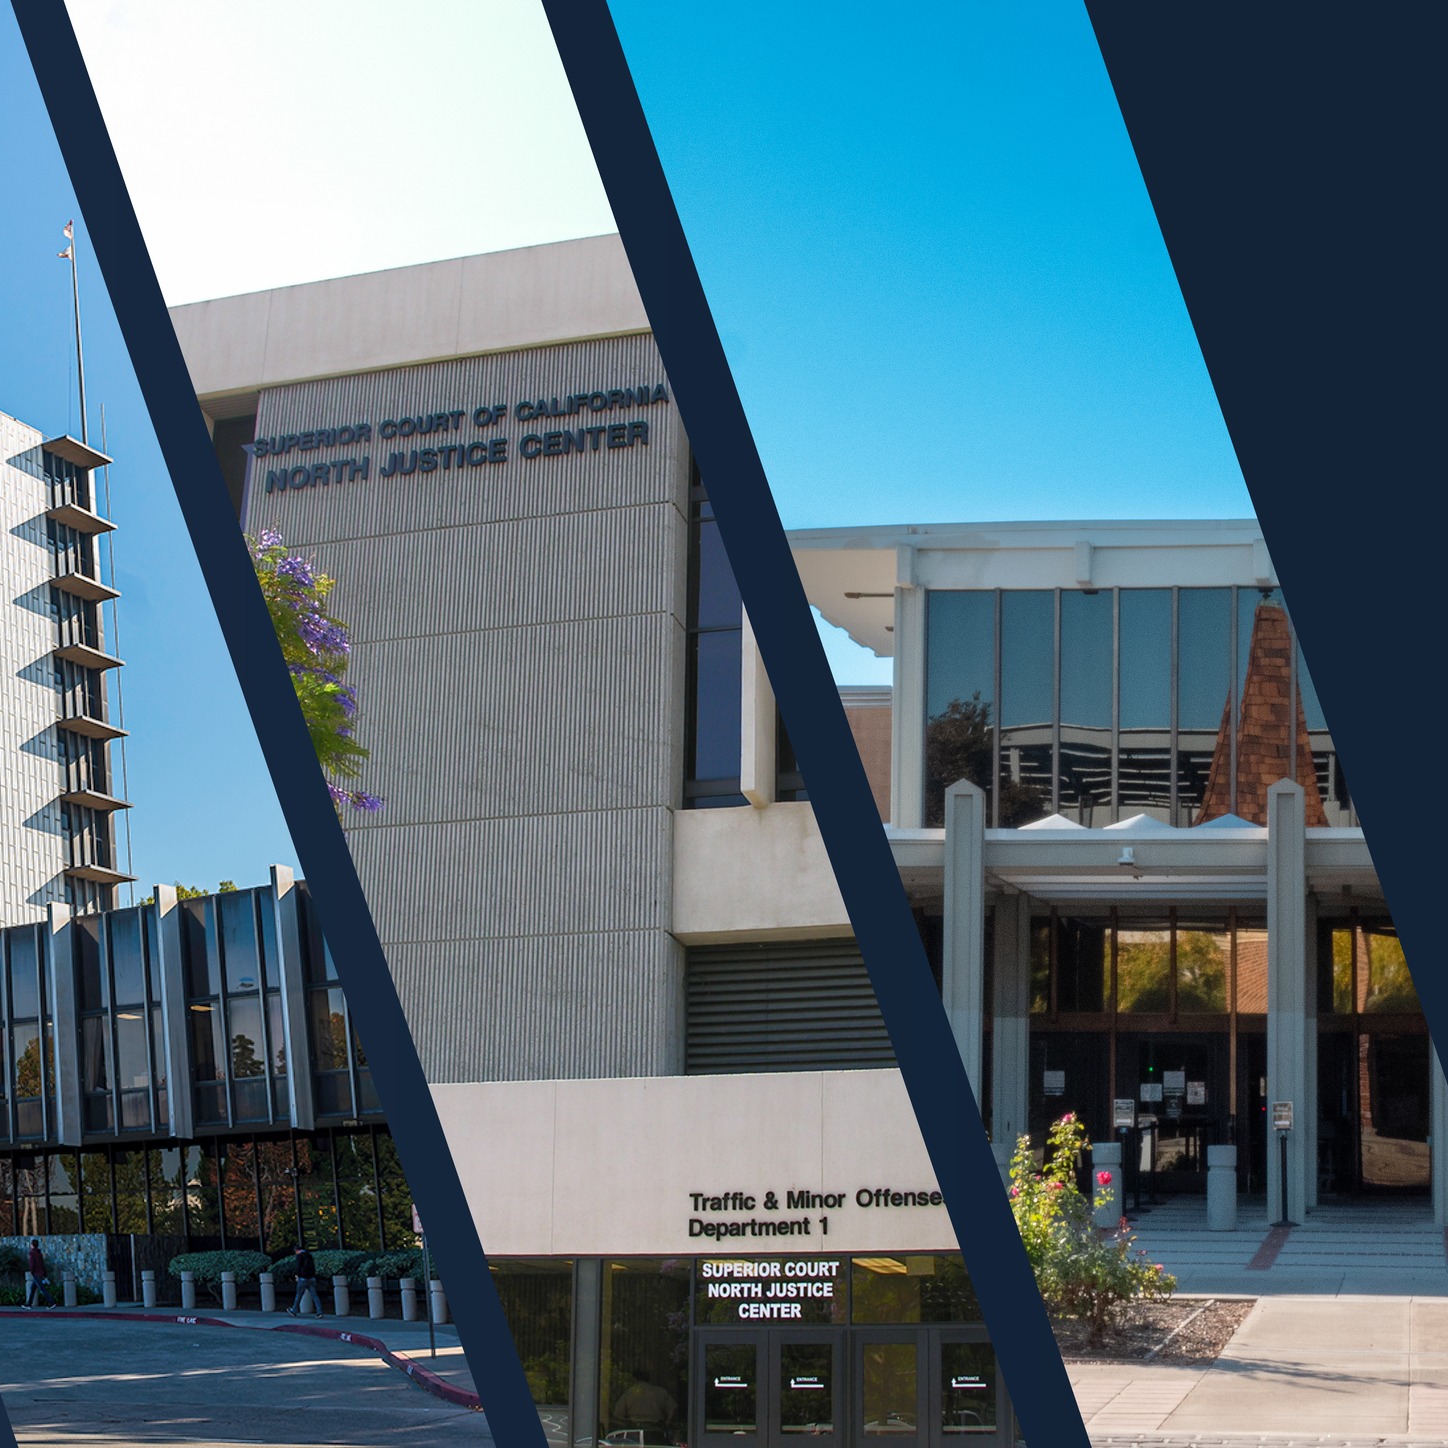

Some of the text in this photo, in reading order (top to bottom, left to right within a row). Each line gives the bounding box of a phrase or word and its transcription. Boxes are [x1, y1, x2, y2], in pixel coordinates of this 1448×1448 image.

[253, 383, 670, 458] SUPERIOR COURT OF CALIFORNIA
[265, 420, 649, 493] NORTH JUSTICE CENTER
[689, 1187, 947, 1211] Traffic & Minor Offense
[688, 1217, 829, 1241] Department 1
[702, 1261, 840, 1278] SUPERIOR COURT
[707, 1281, 834, 1298] NORTH JUSTICE
[738, 1302, 802, 1318] CENTER
